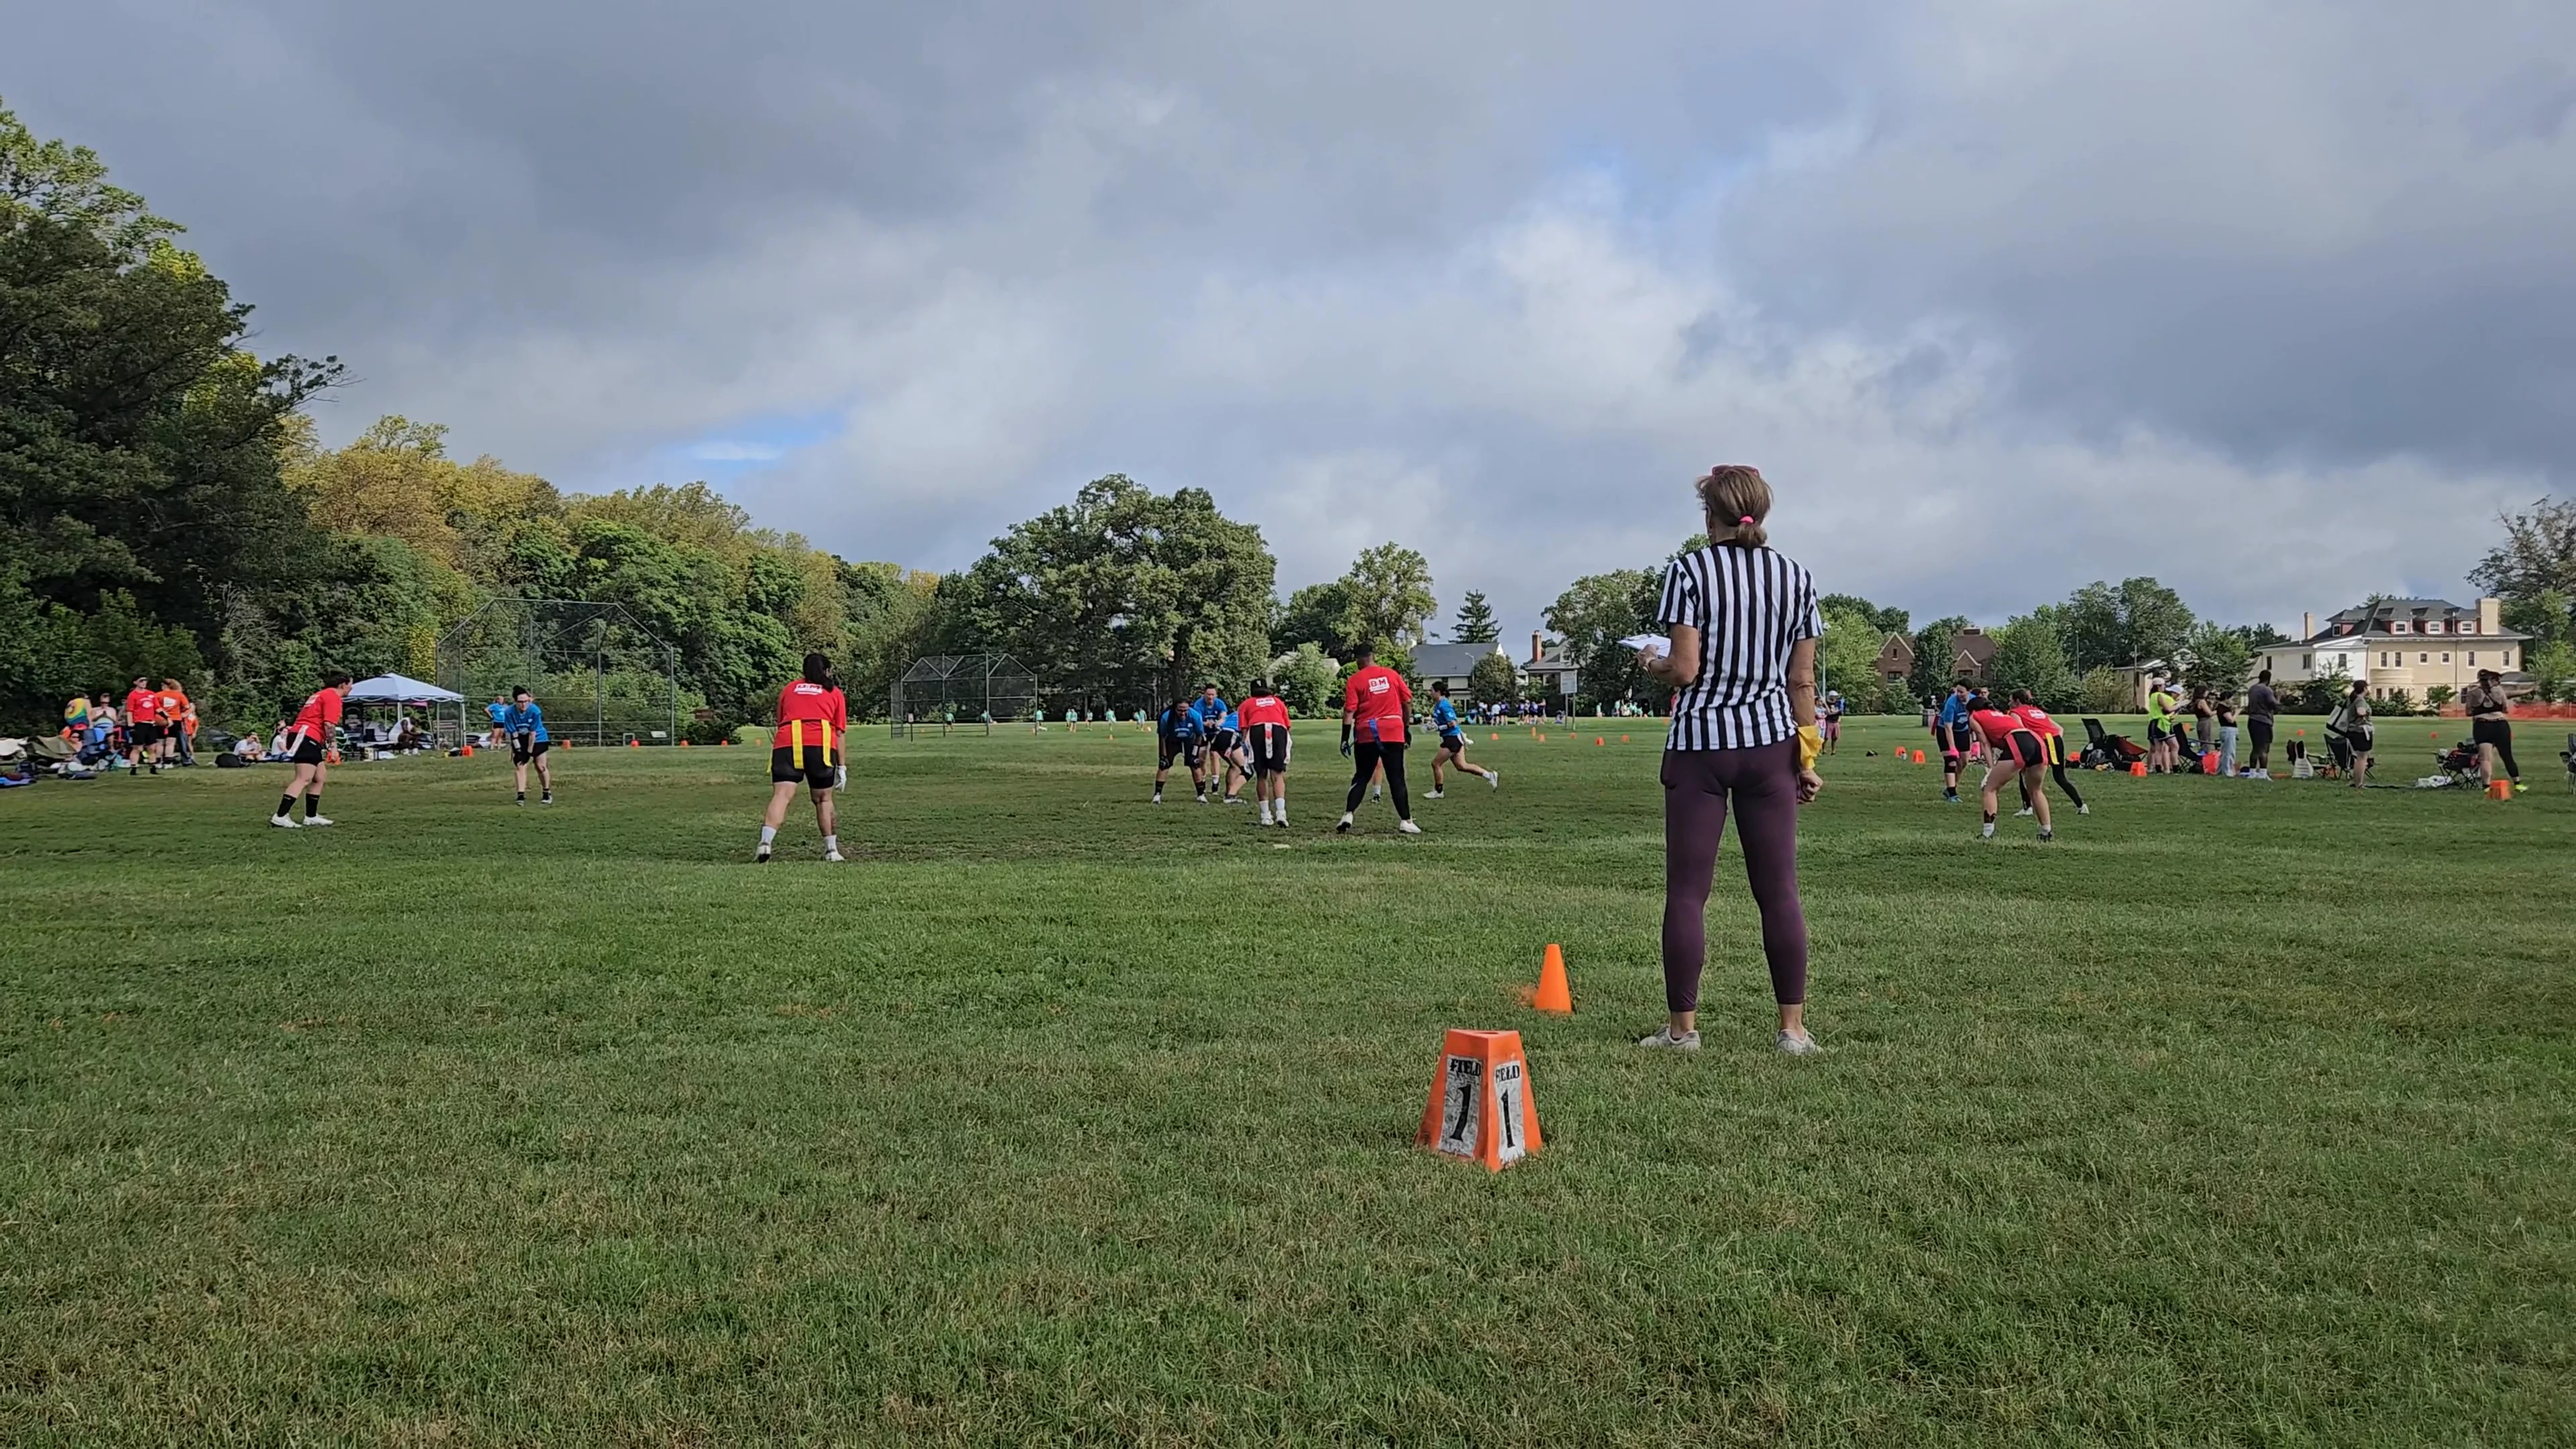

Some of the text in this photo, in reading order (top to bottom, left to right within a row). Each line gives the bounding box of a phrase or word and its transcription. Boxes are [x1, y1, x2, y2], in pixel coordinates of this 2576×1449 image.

[1450, 1059, 1481, 1077] FIELD
[1450, 1083, 1471, 1142] 1
[1501, 1089, 1515, 1148] 1
